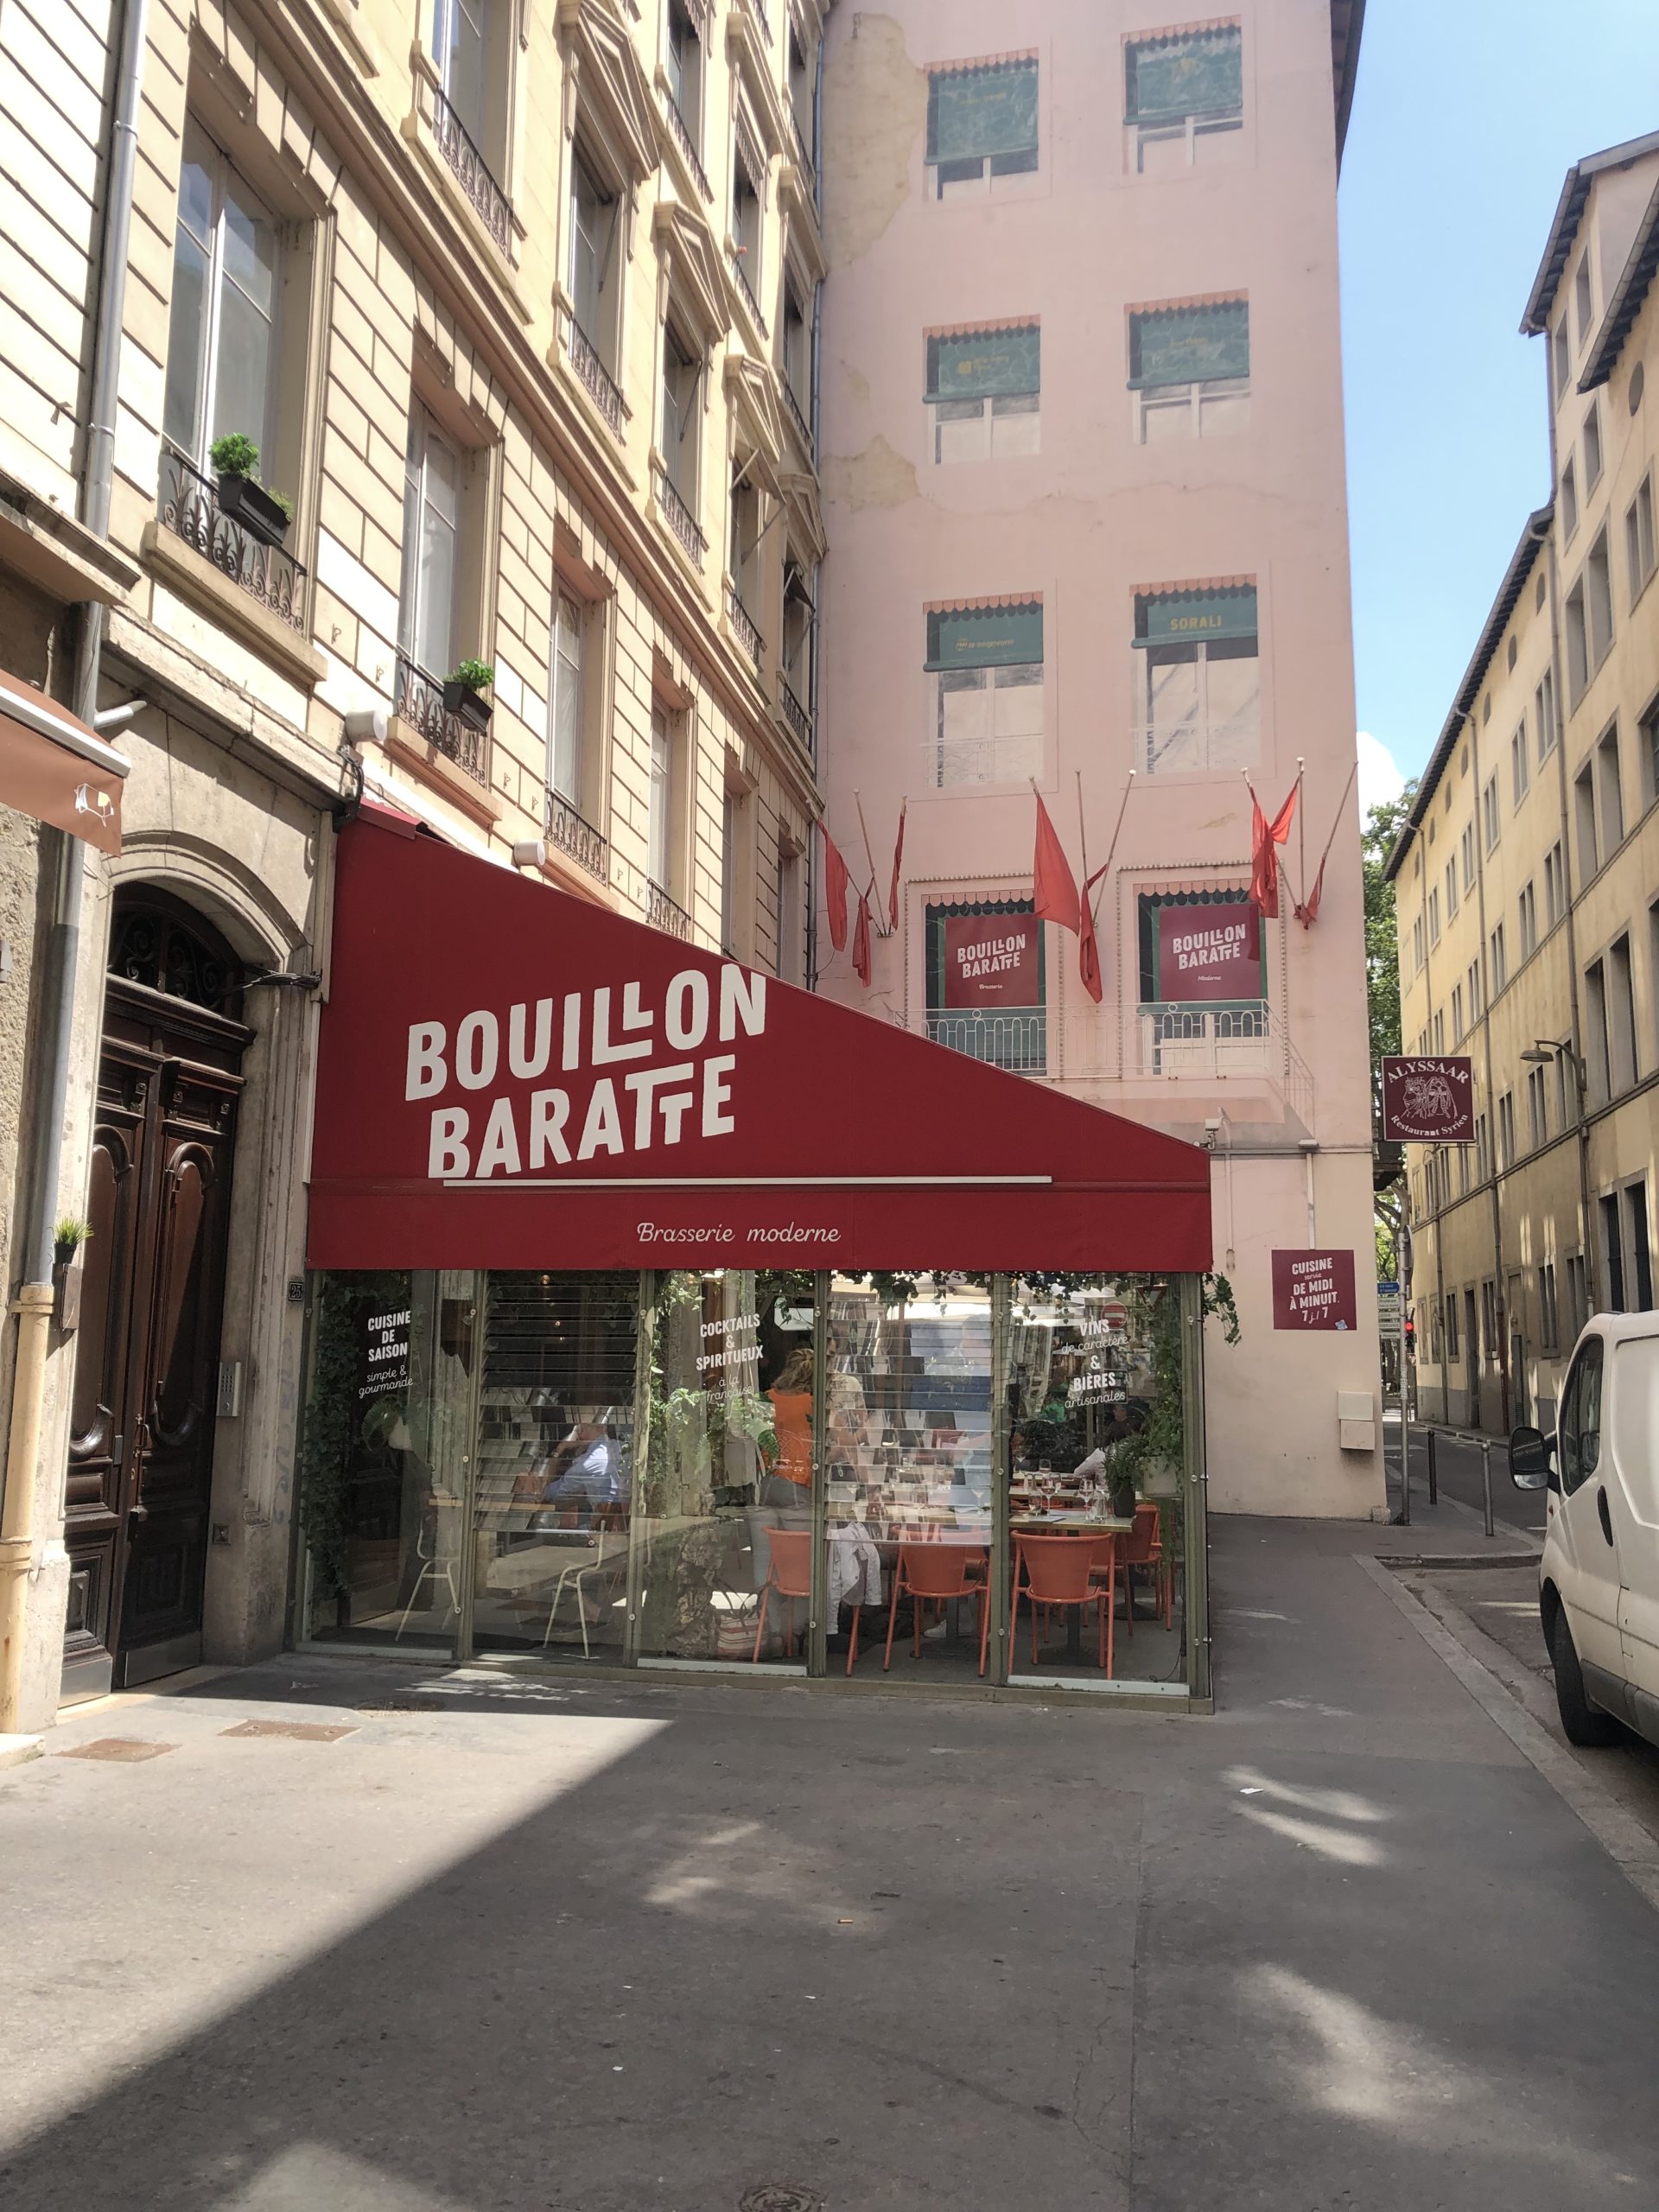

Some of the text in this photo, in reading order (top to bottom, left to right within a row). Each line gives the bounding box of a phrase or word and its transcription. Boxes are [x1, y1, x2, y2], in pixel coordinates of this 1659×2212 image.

[1170, 614, 1222, 631] SORALI
[957, 933, 1026, 963] BOUILLON
[1173, 924, 1246, 954] BOUILLON
[962, 951, 1020, 979] BARATTE
[1179, 942, 1241, 969] BARATTE
[404, 963, 766, 1102] BOUILLON
[1388, 1060, 1469, 1084] ALYSSAAR
[428, 1054, 736, 1179] BARATTE
[1390, 1114, 1469, 1136] Restaurant Syrien
[637, 1221, 842, 1243] Brasserie moderne
[1292, 1257, 1333, 1275] CUISINE
[291, 1285, 301, 1298] 25
[1293, 1278, 1333, 1296] DE MIDI
[1289, 1291, 1340, 1310] À MINUIT.
[367, 1310, 411, 1332] CUISINE
[700, 1313, 760, 1338] COCKTAILS
[1079, 1319, 1109, 1337] VINS
[381, 1329, 395, 1344] DE
[726, 1335, 734, 1348] &
[1061, 1335, 1128, 1354] de caractère
[368, 1342, 408, 1362] SAISON
[696, 1344, 764, 1371] SPIRITUEUX
[1090, 1355, 1101, 1370] &
[366, 1365, 407, 1382] simple &
[728, 1373, 740, 1385] la
[1073, 1372, 1116, 1392] BIÈRES
[359, 1376, 414, 1399] gourmande
[1064, 1389, 1126, 1408] artisanales
